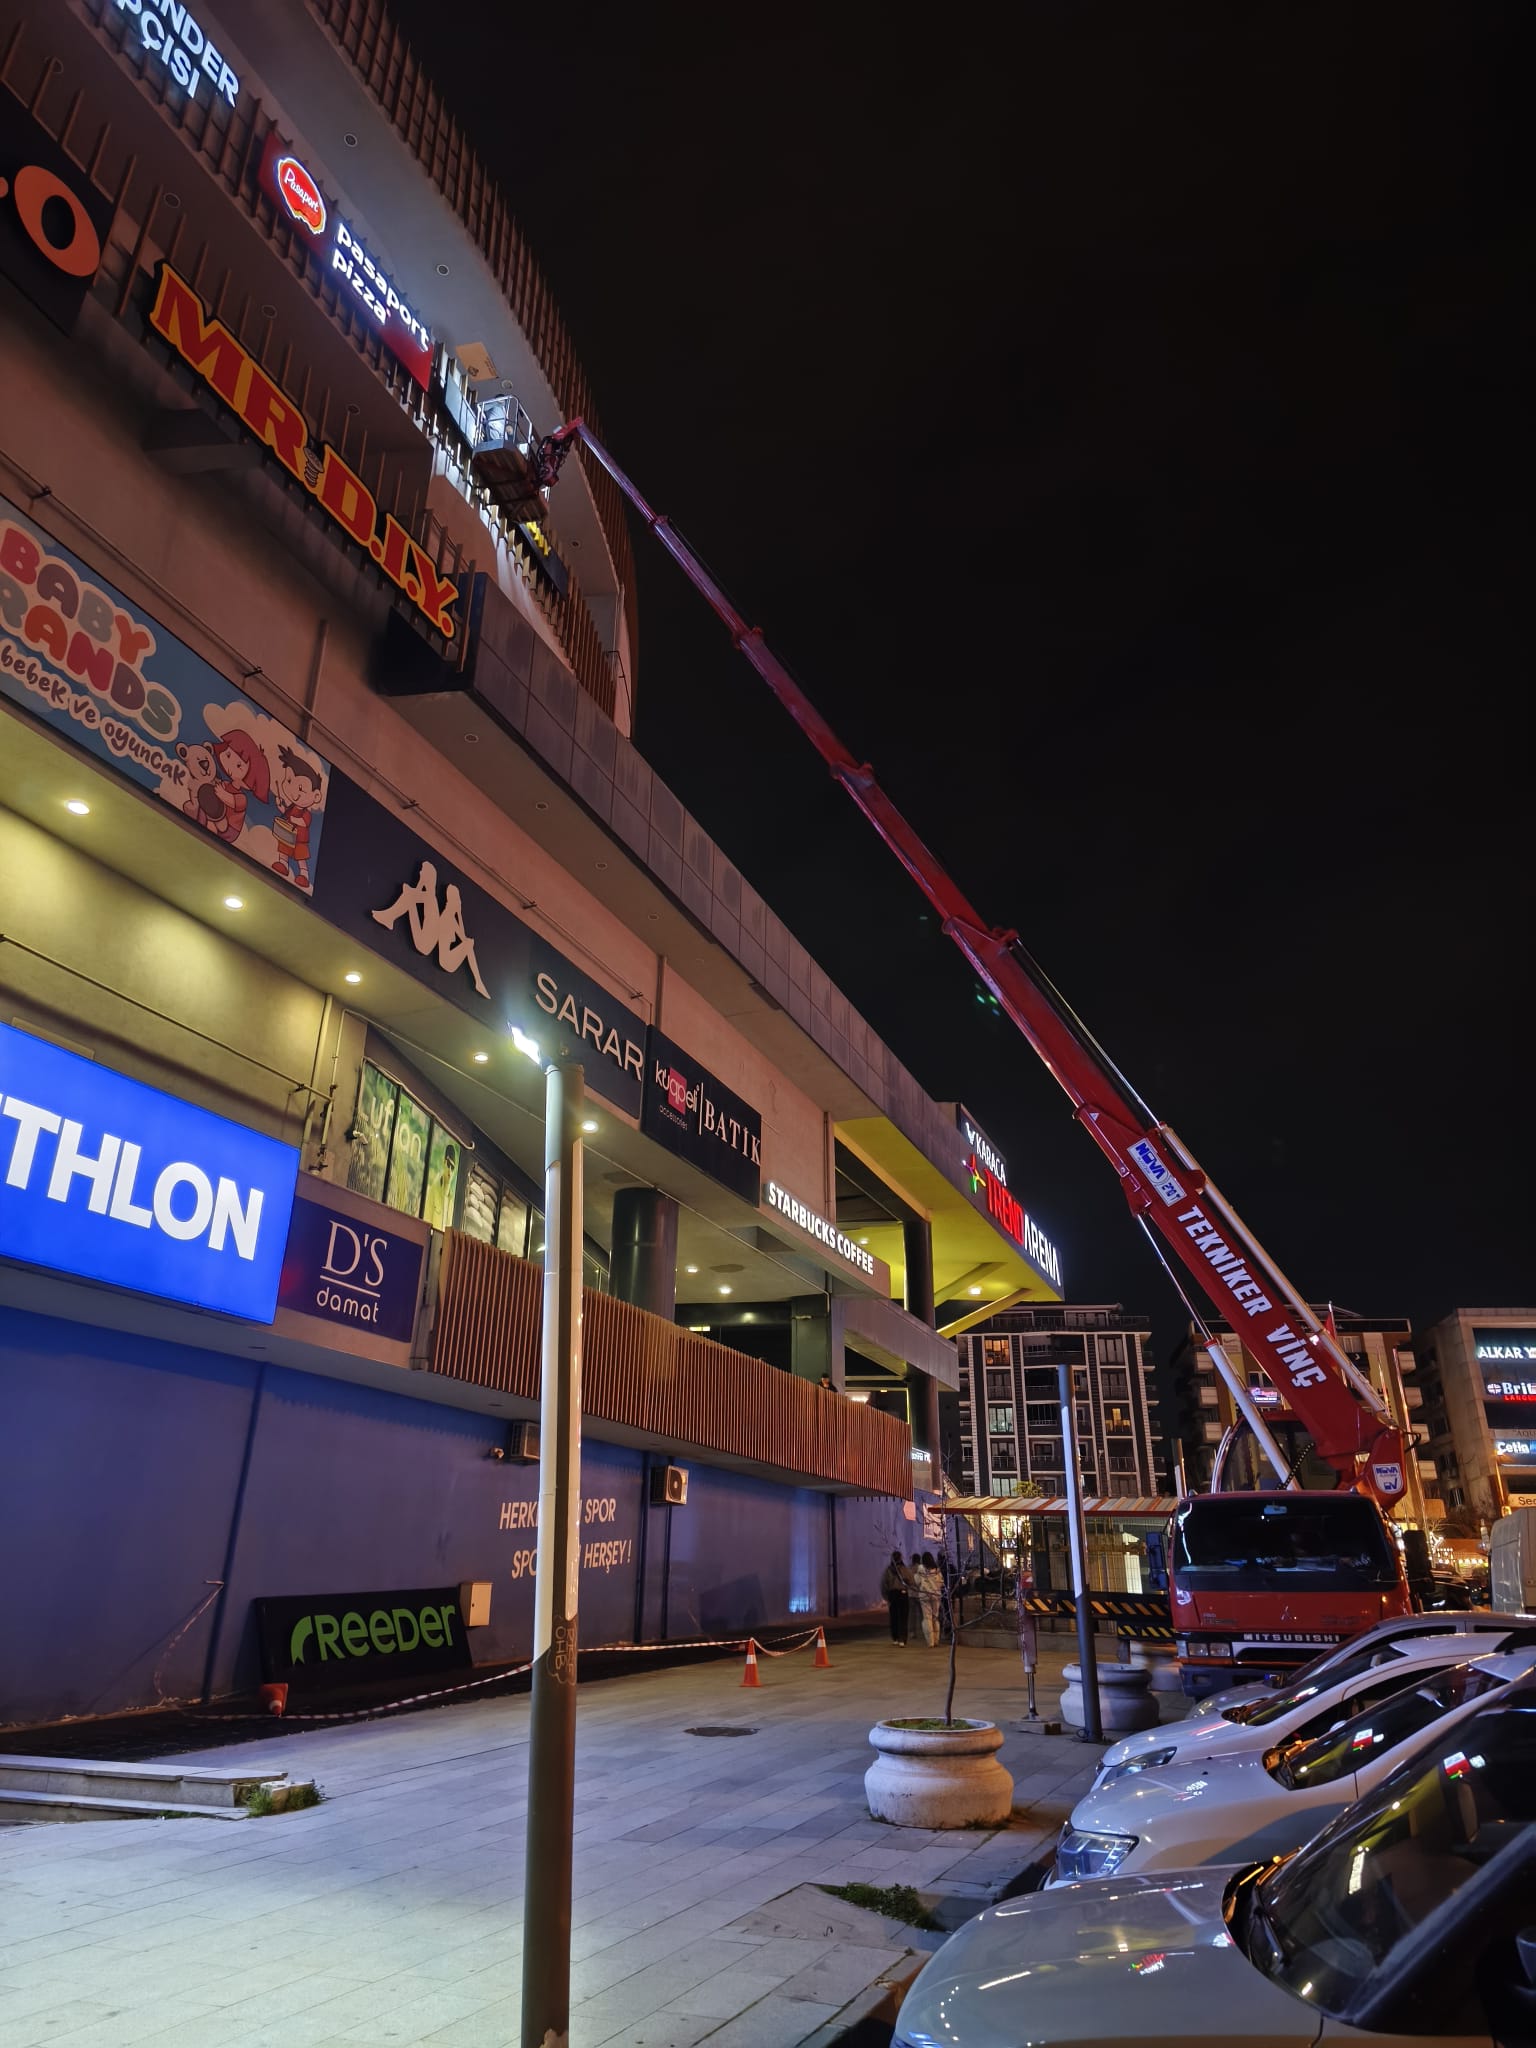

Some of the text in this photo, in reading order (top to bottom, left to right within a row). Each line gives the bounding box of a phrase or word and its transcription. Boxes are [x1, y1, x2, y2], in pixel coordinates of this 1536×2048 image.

[150, 0, 239, 108] NDER
[284, 167, 320, 213] Pasaport
[332, 249, 388, 325] pizza
[337, 222, 430, 352] pasaport
[317, 445, 459, 638] D.I.Y.
[0, 527, 150, 665] BABY
[72, 699, 97, 725] ve
[535, 972, 644, 1082] SARAR
[704, 1098, 760, 1167] BATİK
[975, 1132, 1007, 1187] KARACA
[1135, 1142, 1166, 1180] NOVA
[322, 1220, 389, 1287] D'S
[769, 1182, 874, 1276] STARBUCKS COFFEE
[316, 1286, 380, 1325] damat
[1177, 1204, 1327, 1389] TEKNİKER VİNÇ
[1477, 1346, 1522, 1359] ALKAR
[498, 1501, 539, 1531] HERK
[585, 1498, 617, 1525] SPOR
[1243, 1633, 1341, 1643] MITSUBISHI
